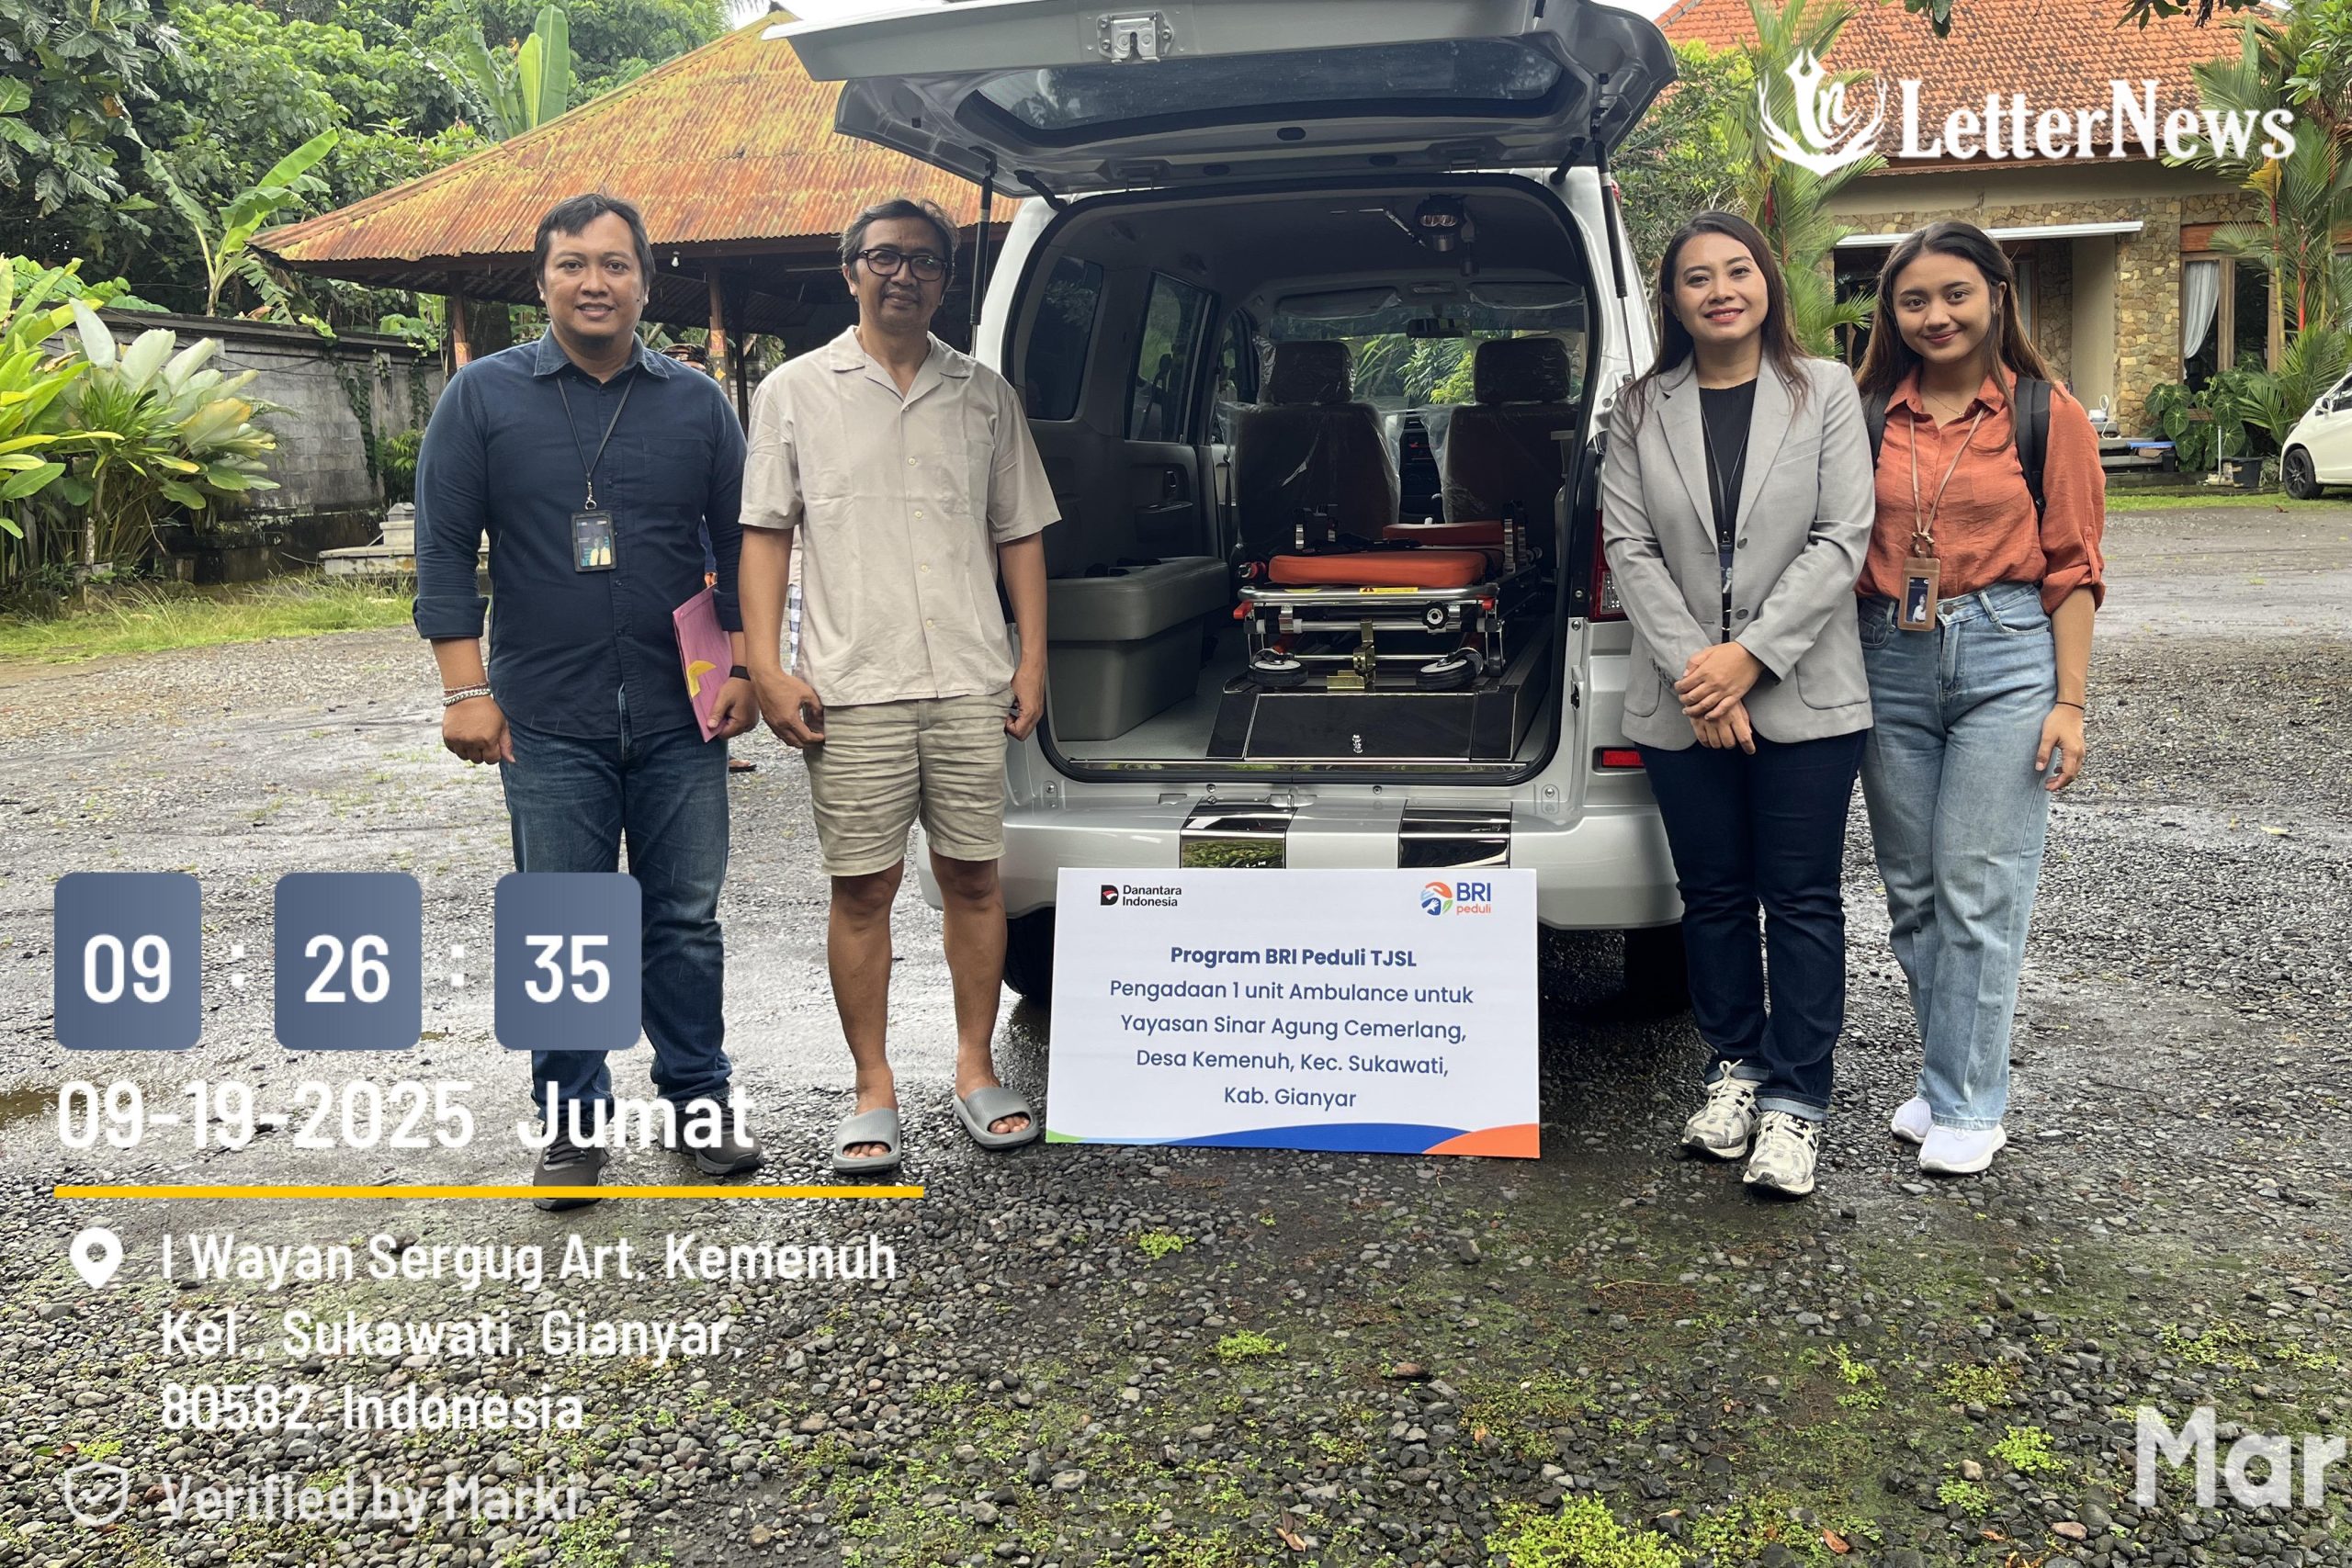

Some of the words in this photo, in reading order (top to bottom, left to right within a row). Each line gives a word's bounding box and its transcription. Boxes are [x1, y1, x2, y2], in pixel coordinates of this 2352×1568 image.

[1123, 885, 1182, 897] Danantara
[1123, 896, 1179, 908] Indonesia
[1457, 883, 1492, 902] BRI
[1456, 903, 1492, 915] peduli
[1170, 946, 1261, 970] Program
[1265, 948, 1297, 965] BRI
[1302, 948, 1366, 967] Peduli
[1370, 950, 1418, 968] TJSL
[1110, 980, 1227, 1003] Pengadaan
[1232, 981, 1238, 998] 1
[1244, 982, 1284, 1000] unit
[1289, 983, 1408, 1003] Ambulance
[1414, 986, 1475, 1004] untuk
[1120, 1014, 1208, 1035] Yayasan
[1214, 1016, 1266, 1034] Sinar
[1271, 1018, 1339, 1041] Agung
[1343, 1019, 1467, 1043] Cemerlang,
[1136, 1049, 1187, 1067] Desa
[1193, 1050, 1295, 1073] Kemenuh,
[1300, 1054, 1343, 1072] Kec.
[1348, 1055, 1449, 1077] Sukawati,
[1224, 1087, 1270, 1105] Kab.
[1274, 1089, 1357, 1111] Gianyar
